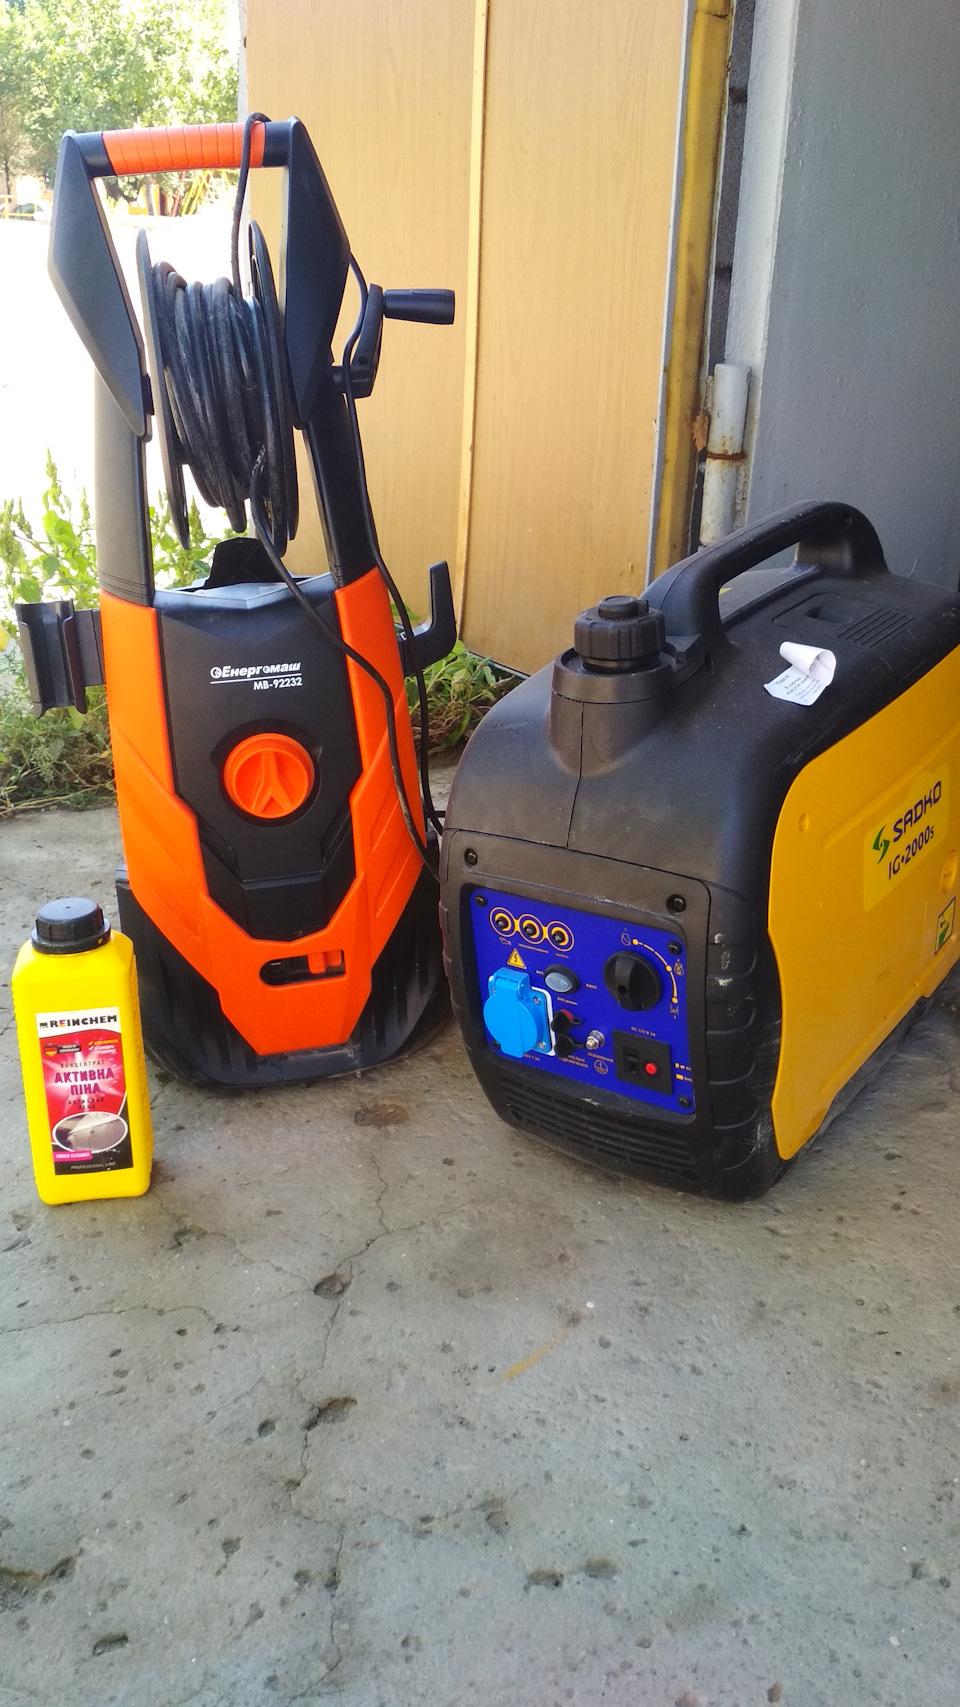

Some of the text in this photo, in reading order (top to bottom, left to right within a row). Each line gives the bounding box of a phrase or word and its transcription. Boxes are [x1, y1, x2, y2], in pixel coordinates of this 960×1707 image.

[221, 662, 301, 678] Енергомаш
[893, 780, 941, 843] SADKO
[49, 1014, 118, 1028] REINCHEM
[60, 1059, 105, 1069] КОНЦЕНТРАТ
[54, 1067, 115, 1084] АКТИВНА
[70, 1083, 102, 1096] ПІНА
